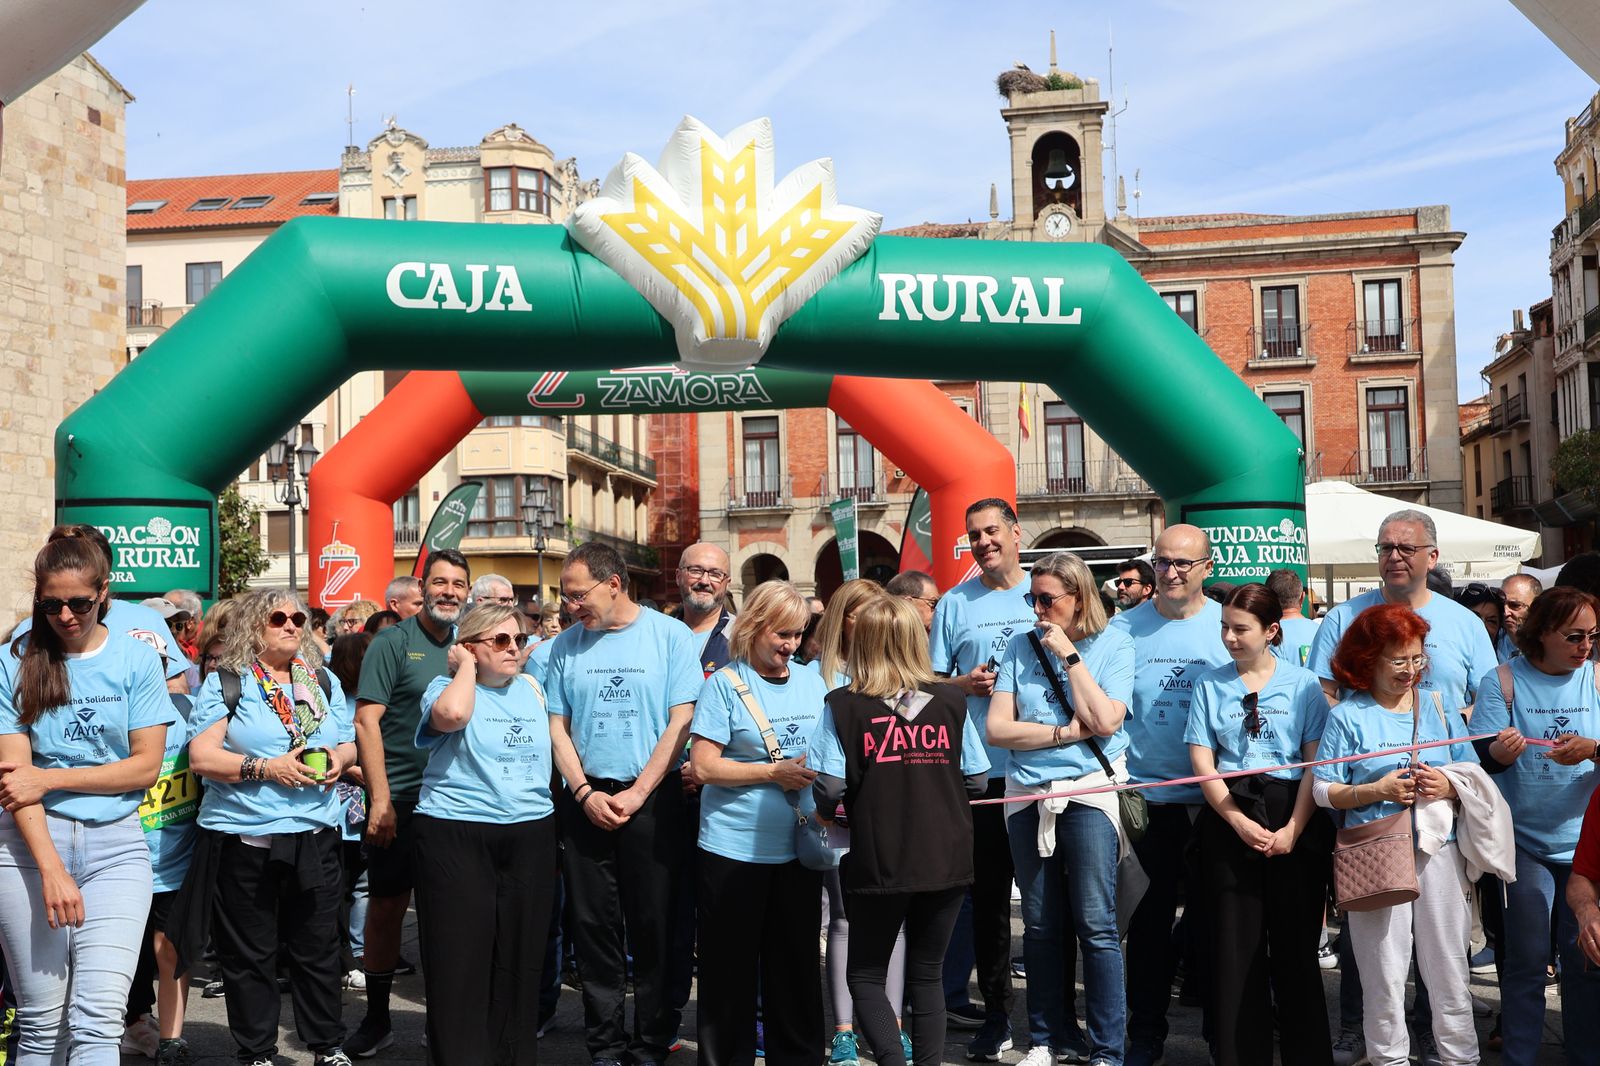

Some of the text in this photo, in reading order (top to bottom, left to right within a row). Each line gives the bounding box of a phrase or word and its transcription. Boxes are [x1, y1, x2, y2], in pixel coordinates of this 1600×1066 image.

[386, 262, 1082, 325] CAJA RURAL
[597, 373, 773, 407] ZAMORA
[117, 547, 200, 568] RURAL
[1206, 545, 1307, 565] AJA RURAL
[1219, 566, 1271, 577] ZAMORA
[1159, 675, 1192, 691] AZAYCA
[85, 695, 122, 704] Solidaria
[598, 686, 631, 702] AZAYCA
[503, 732, 534, 747] AZAYCA
[863, 715, 950, 763] AZAYCA
